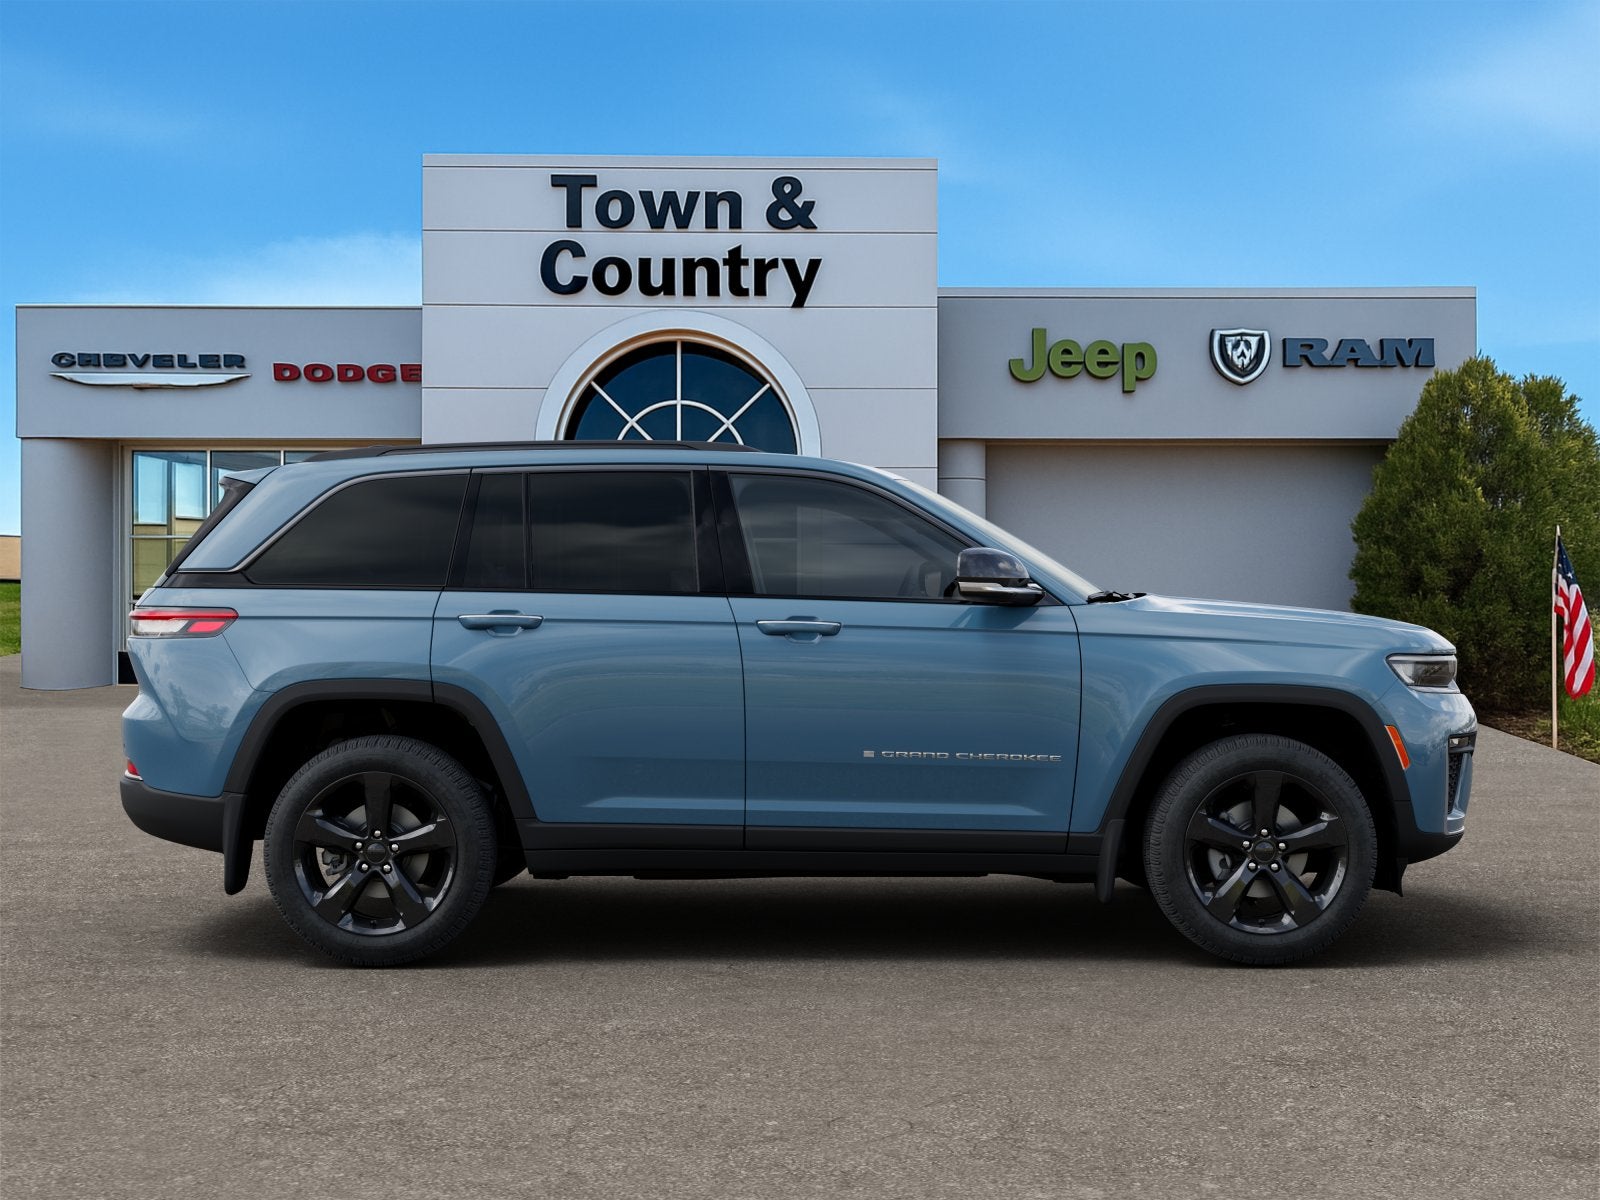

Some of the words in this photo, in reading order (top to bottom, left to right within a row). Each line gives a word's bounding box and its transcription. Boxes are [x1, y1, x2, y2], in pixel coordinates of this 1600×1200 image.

[550, 174, 742, 229] Town
[765, 176, 818, 229] &
[540, 239, 822, 308] Country
[272, 363, 422, 383] DODGE
[1008, 327, 1157, 393] Jeep
[1282, 337, 1435, 368] RAM
[881, 750, 950, 759] GRAND
[955, 752, 1063, 762] CHEROKEE
